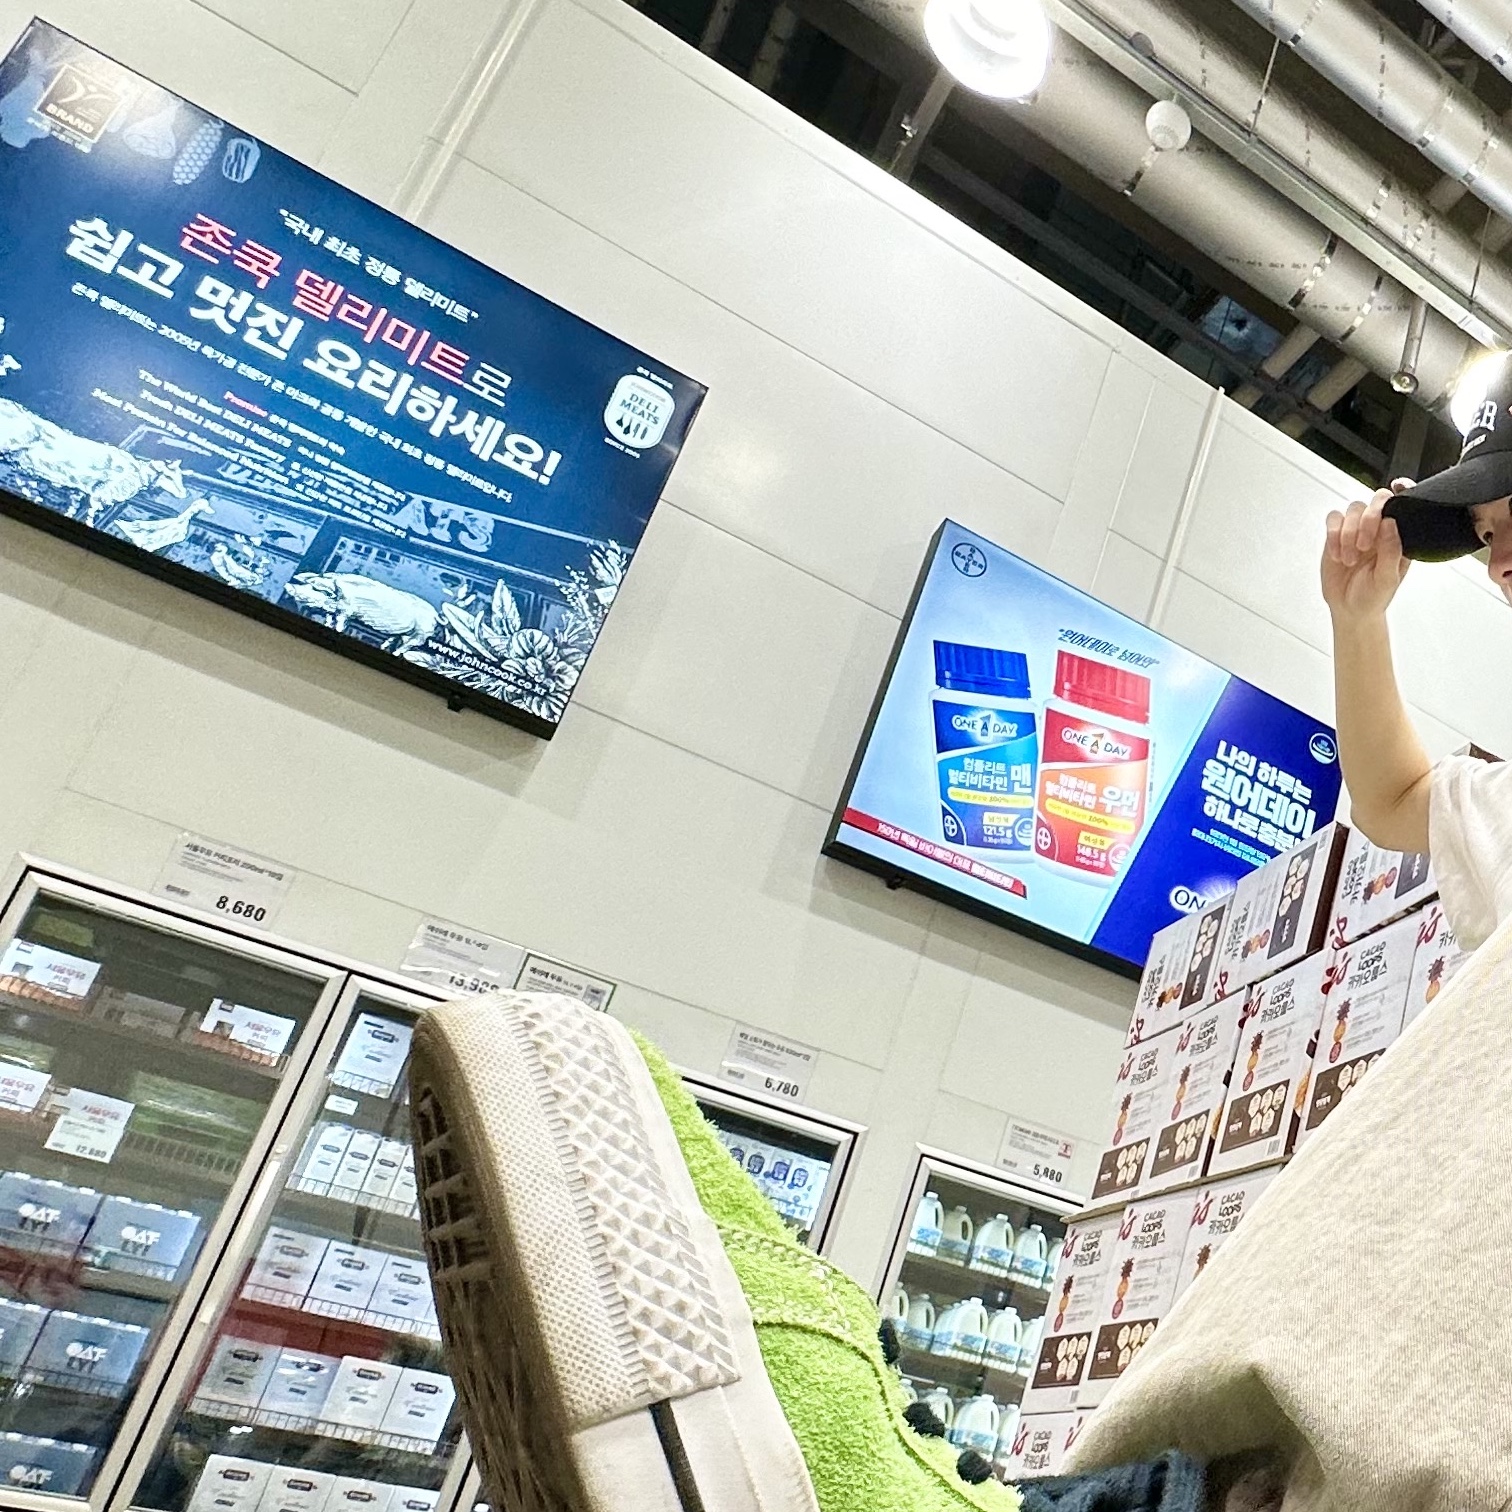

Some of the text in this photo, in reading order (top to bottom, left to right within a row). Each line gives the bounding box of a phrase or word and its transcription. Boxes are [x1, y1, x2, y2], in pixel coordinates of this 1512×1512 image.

[46, 103, 94, 134] BRAND
[180, 213, 513, 407] 존쿡 델리미트로
[66, 217, 185, 299] 쉽고
[189, 275, 305, 361] 멋진
[303, 339, 562, 486] 요리하세요!
[620, 398, 661, 426] MEATS
[629, 392, 659, 414] DELI
[954, 550, 984, 570] BAYER
[953, 717, 1016, 734] ONE DAY
[1063, 730, 1129, 757] ONE DAY
[1011, 763, 1032, 793] 맨
[1216, 740, 1313, 805] 나의 하루는
[1100, 785, 1141, 817] 우먼
[1201, 758, 1316, 839] 원어데이
[216, 895, 266, 921] 8,680
[1358, 952, 1383, 971] LOOPS
[1360, 941, 1386, 959] CACAO
[1272, 978, 1295, 995] CACAO
[764, 1076, 799, 1098] 6,780
[1221, 1191, 1246, 1204] CACAO
